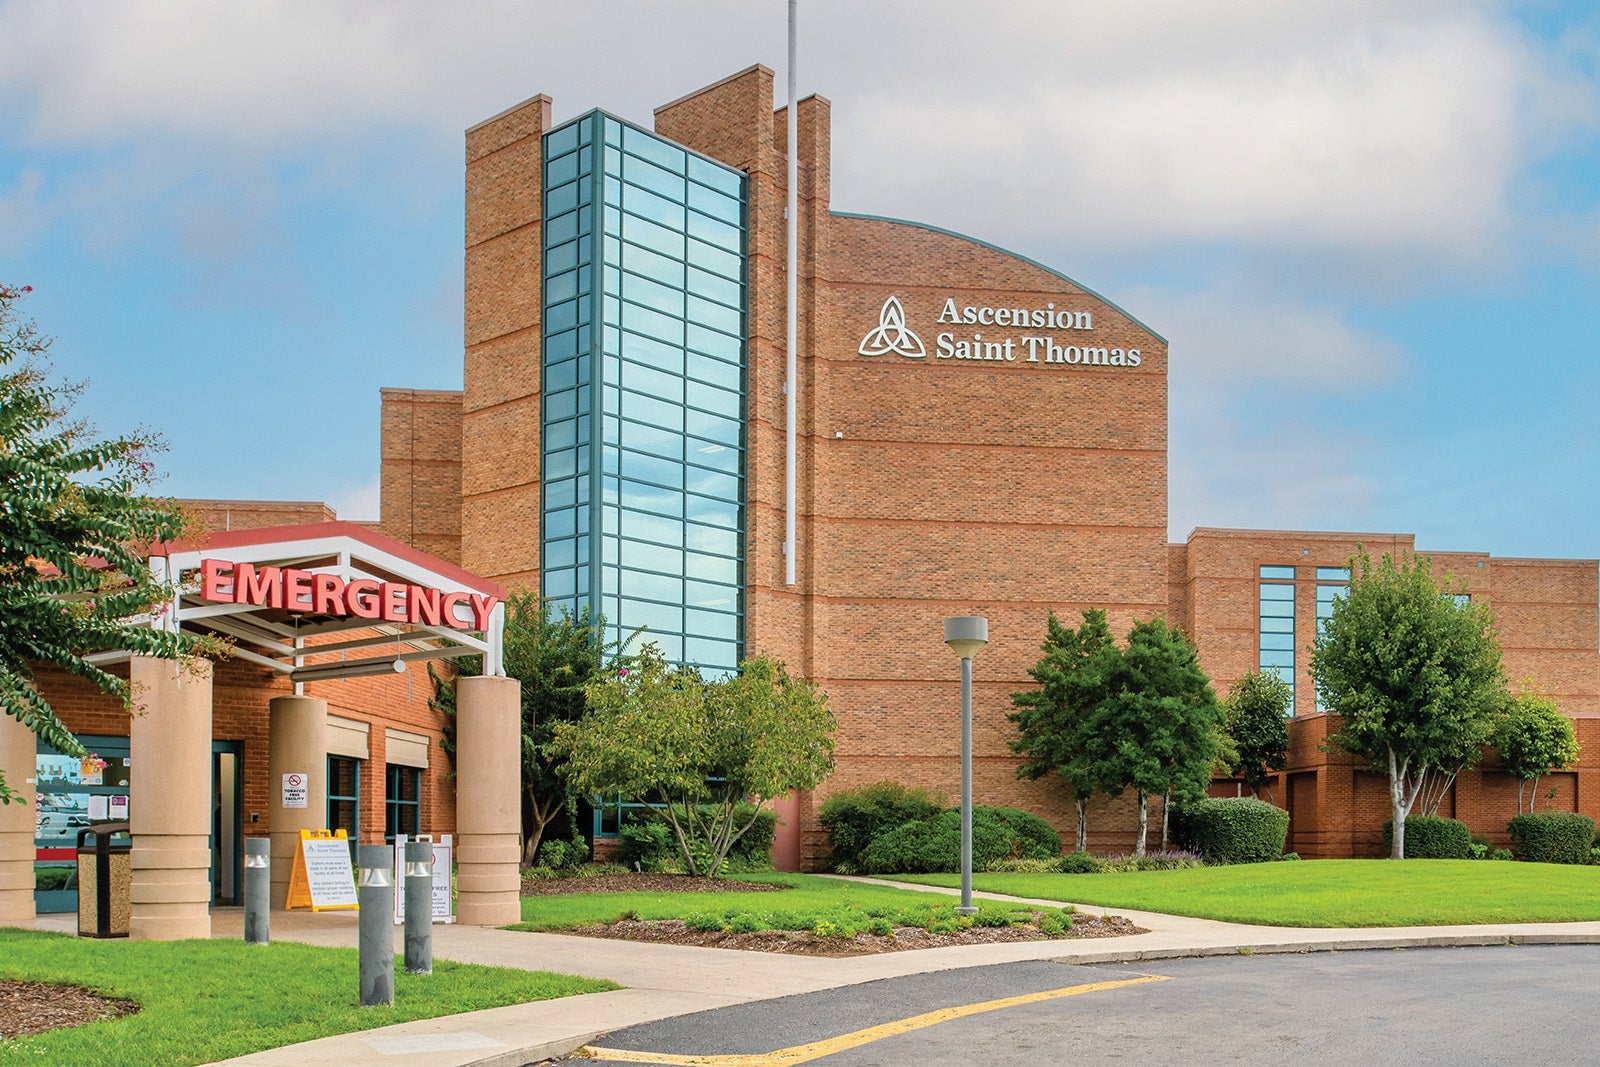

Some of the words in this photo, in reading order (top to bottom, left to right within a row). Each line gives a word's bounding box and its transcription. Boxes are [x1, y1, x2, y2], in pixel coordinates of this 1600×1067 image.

[937, 297, 1094, 330] Ascension
[936, 332, 1016, 361] Saint
[1021, 336, 1142, 367] Thomas
[201, 559, 499, 632] EMERGENCY
